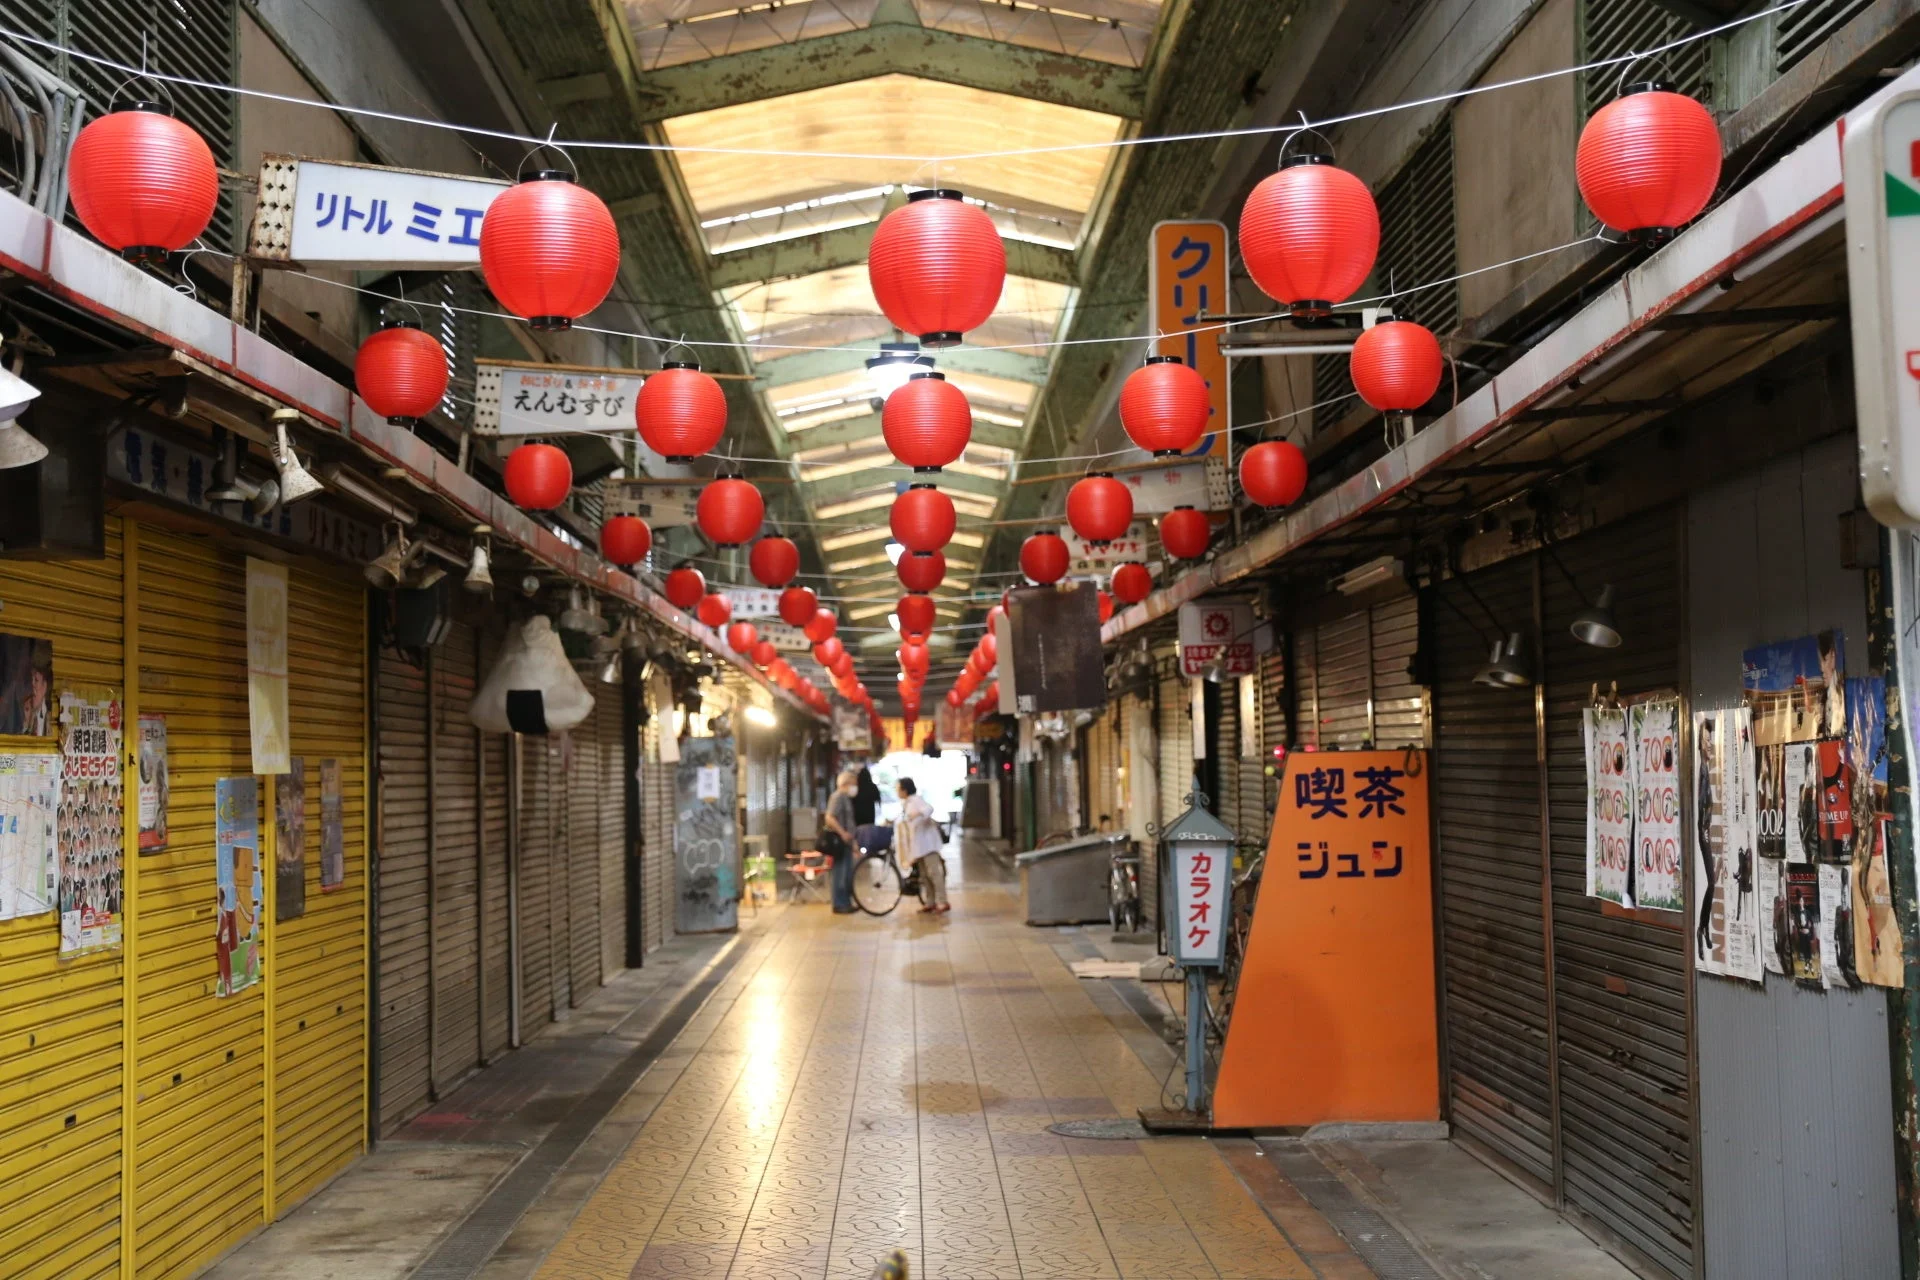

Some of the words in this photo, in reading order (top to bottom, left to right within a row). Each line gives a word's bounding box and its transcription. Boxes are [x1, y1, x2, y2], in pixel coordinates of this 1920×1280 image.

[513, 389, 626, 418] えんむすび
[1186, 645, 1251, 659] 焼きたパン
[1187, 657, 1249, 672] ヤザキ
[73, 728, 107, 754] 朝日劇場
[64, 755, 117, 778] よしもとライブ
[1295, 766, 1406, 819] 喫茶
[1297, 841, 1403, 879] ジュン
[1188, 851, 1212, 949] カラオケ
